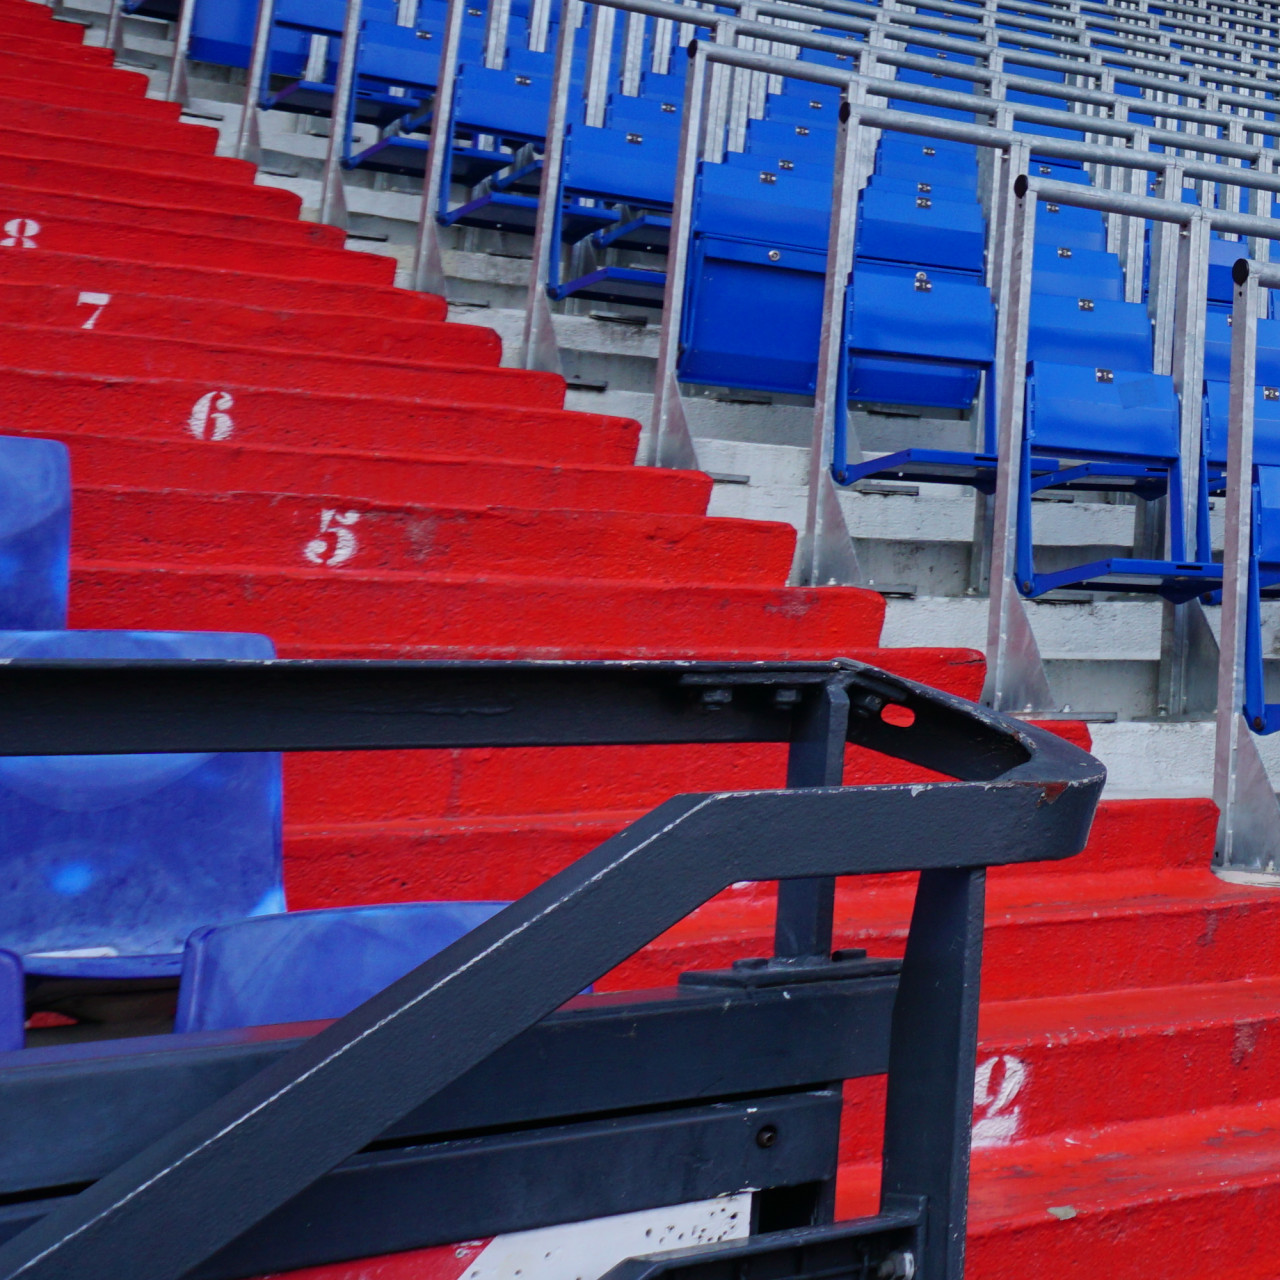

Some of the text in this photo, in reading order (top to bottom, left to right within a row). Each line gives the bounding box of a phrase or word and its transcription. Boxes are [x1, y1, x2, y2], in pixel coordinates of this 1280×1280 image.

[76, 291, 111, 330] 7
[187, 391, 235, 441] 6
[303, 509, 360, 567] 5
[970, 1054, 1027, 1149] 2
